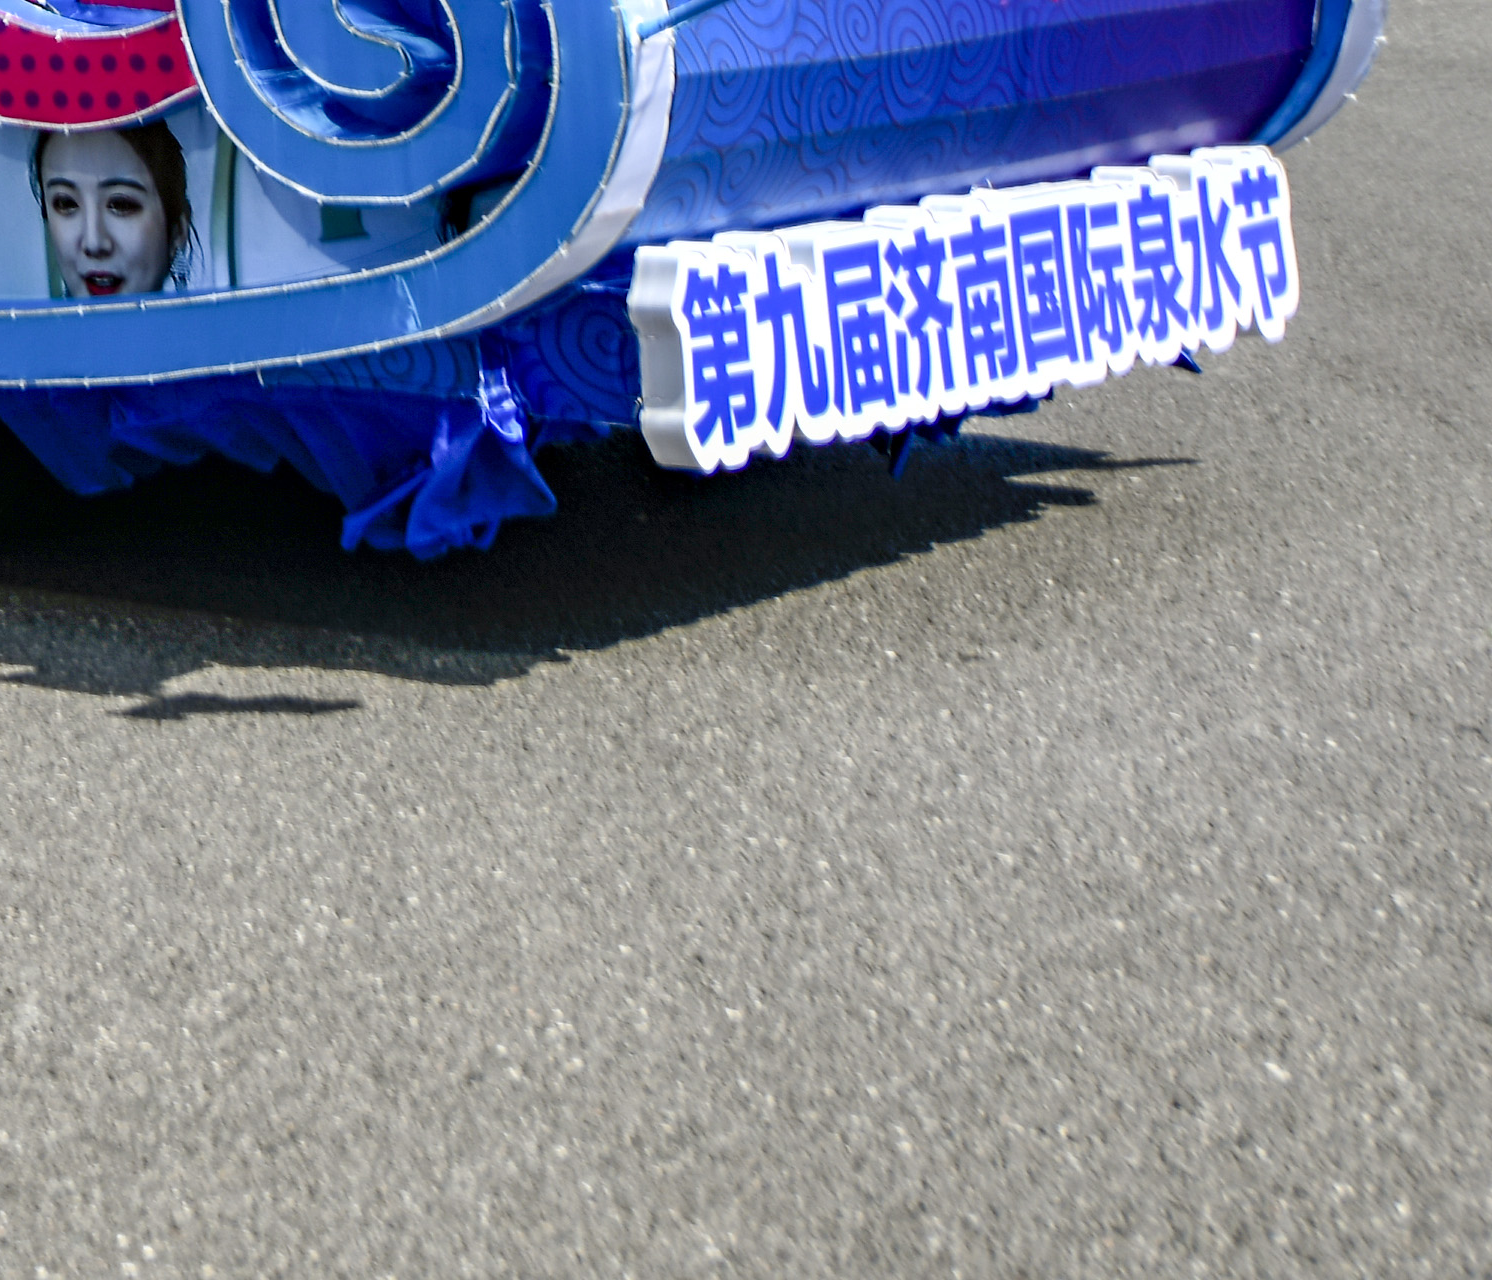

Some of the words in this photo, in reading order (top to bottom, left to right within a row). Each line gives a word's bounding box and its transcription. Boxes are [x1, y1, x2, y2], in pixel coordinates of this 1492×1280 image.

[681, 165, 1290, 447] 第九届济南国际泉水节
